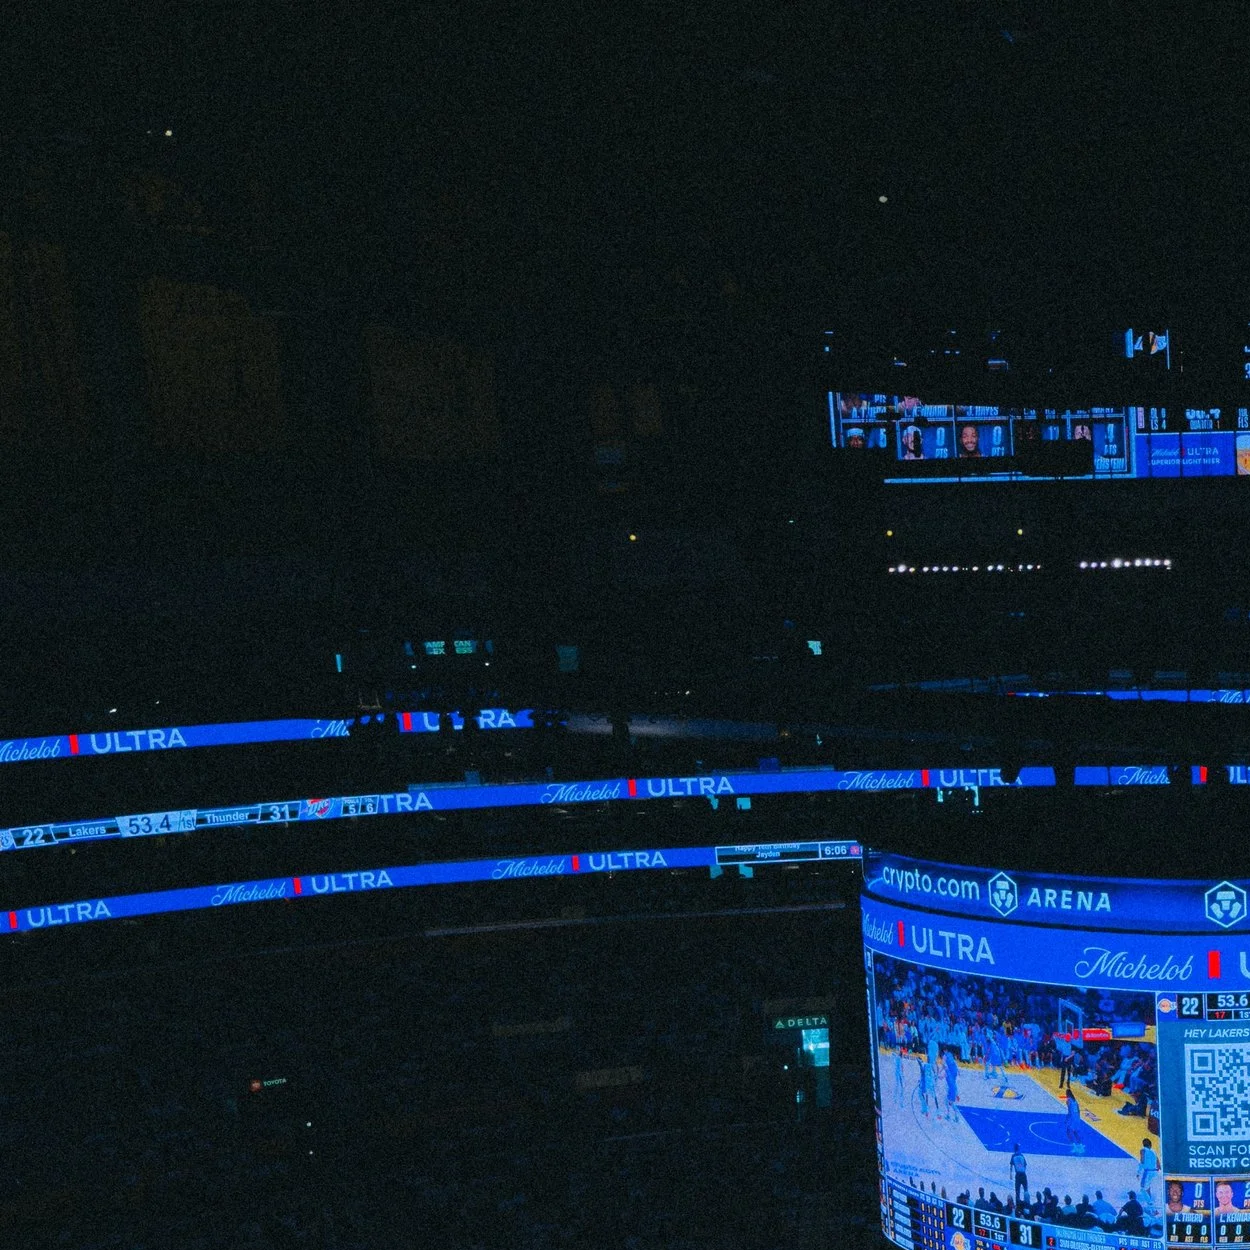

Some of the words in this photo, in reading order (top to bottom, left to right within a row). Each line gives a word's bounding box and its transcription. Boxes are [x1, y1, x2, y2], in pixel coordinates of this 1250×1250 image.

[90, 728, 187, 754] ULTRA
[540, 781, 620, 803] Michelob
[647, 776, 734, 797] ULTRA
[837, 771, 914, 790] Michelob
[939, 768, 1023, 787] ULTR
[381, 792, 433, 813] TRA
[22, 828, 45, 846] 22
[68, 824, 107, 838] Lakers
[128, 814, 172, 835] 53.4
[205, 810, 250, 825] Thunder
[269, 804, 291, 821] 31
[824, 845, 847, 855] 6:06
[492, 859, 565, 879] Michelob
[589, 852, 667, 872] ULTRA
[211, 881, 286, 906] Michelob
[311, 870, 394, 894] ULTRA
[882, 865, 980, 901] crypto.com
[1026, 887, 1112, 912] ARENA
[27, 900, 112, 928] ULTRA
[911, 925, 995, 965] ULTRA
[1074, 946, 1194, 981] Michelob
[1182, 998, 1199, 1015] 22
[1217, 994, 1249, 1007] 53.6
[787, 1017, 828, 1028] DELTA
[1184, 1028, 1206, 1038] HEY
[1208, 1027, 1250, 1038] LAKERS
[263, 1077, 287, 1087] TOYOTA
[1188, 1144, 1225, 1156] SCAN
[1189, 1157, 1238, 1168] RESORT
[1193, 1199, 1205, 1209] PTS
[952, 1207, 965, 1229] 22
[980, 1213, 1000, 1229] 53.6
[1019, 1224, 1032, 1245] 31
[1171, 1224, 1176, 1235] 1
